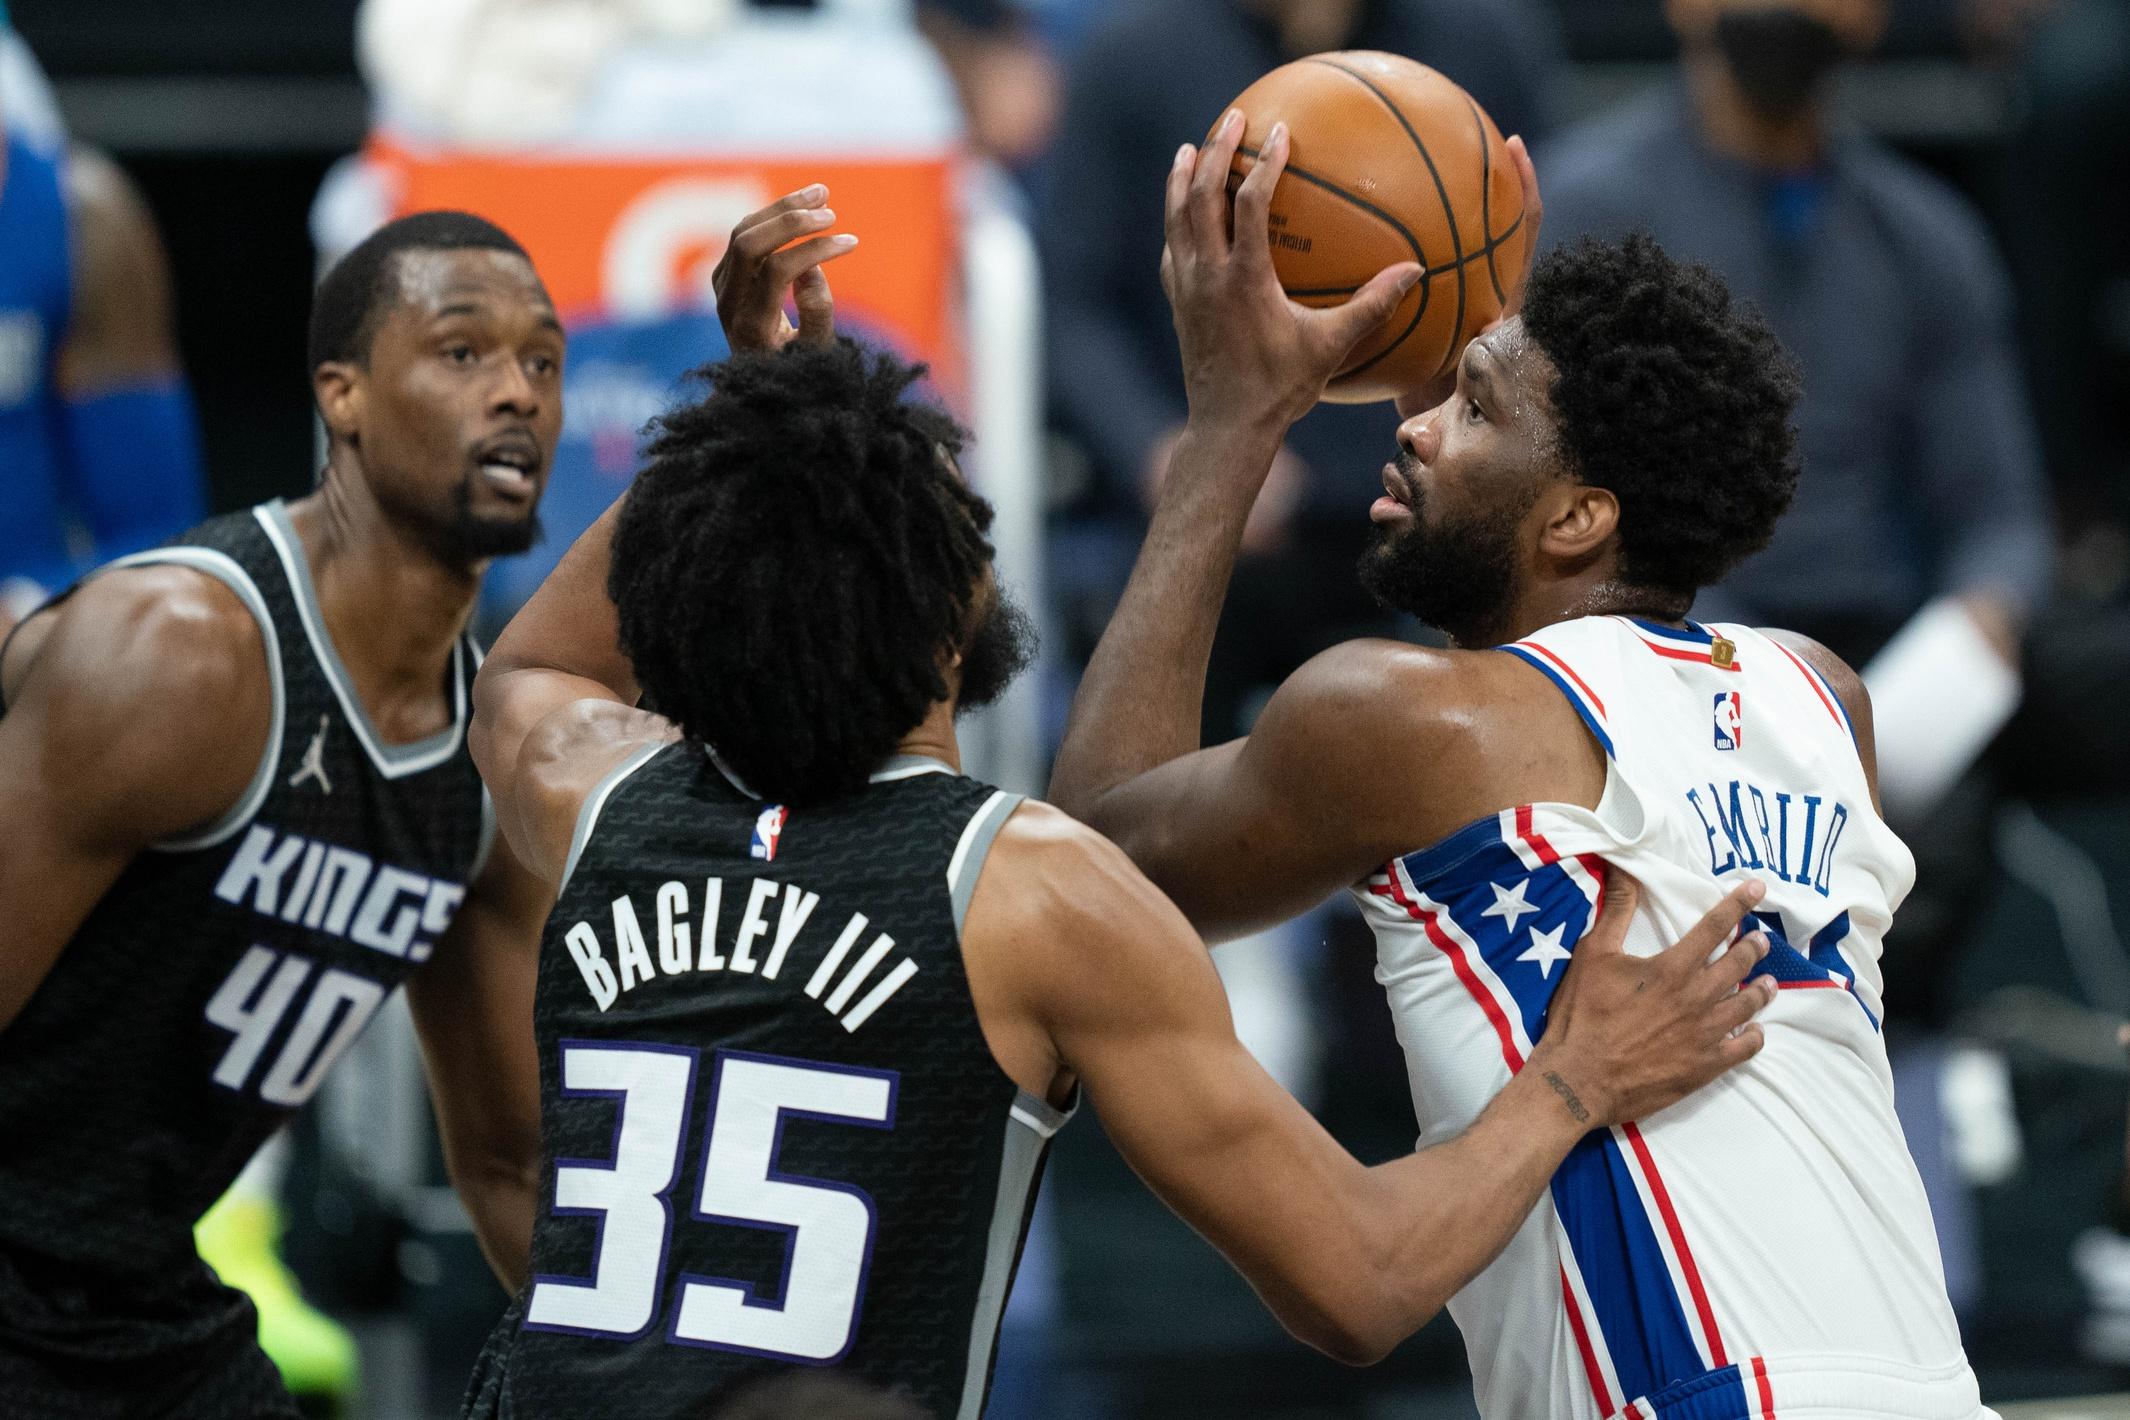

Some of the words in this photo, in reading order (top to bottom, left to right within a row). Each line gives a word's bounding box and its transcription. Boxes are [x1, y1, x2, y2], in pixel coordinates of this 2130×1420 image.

[1716, 738, 1732, 749] NBA
[204, 944, 386, 1106] 40
[564, 877, 820, 1013] BAGLEY
[804, 911, 920, 1034] III
[524, 1040, 898, 1364] 35
